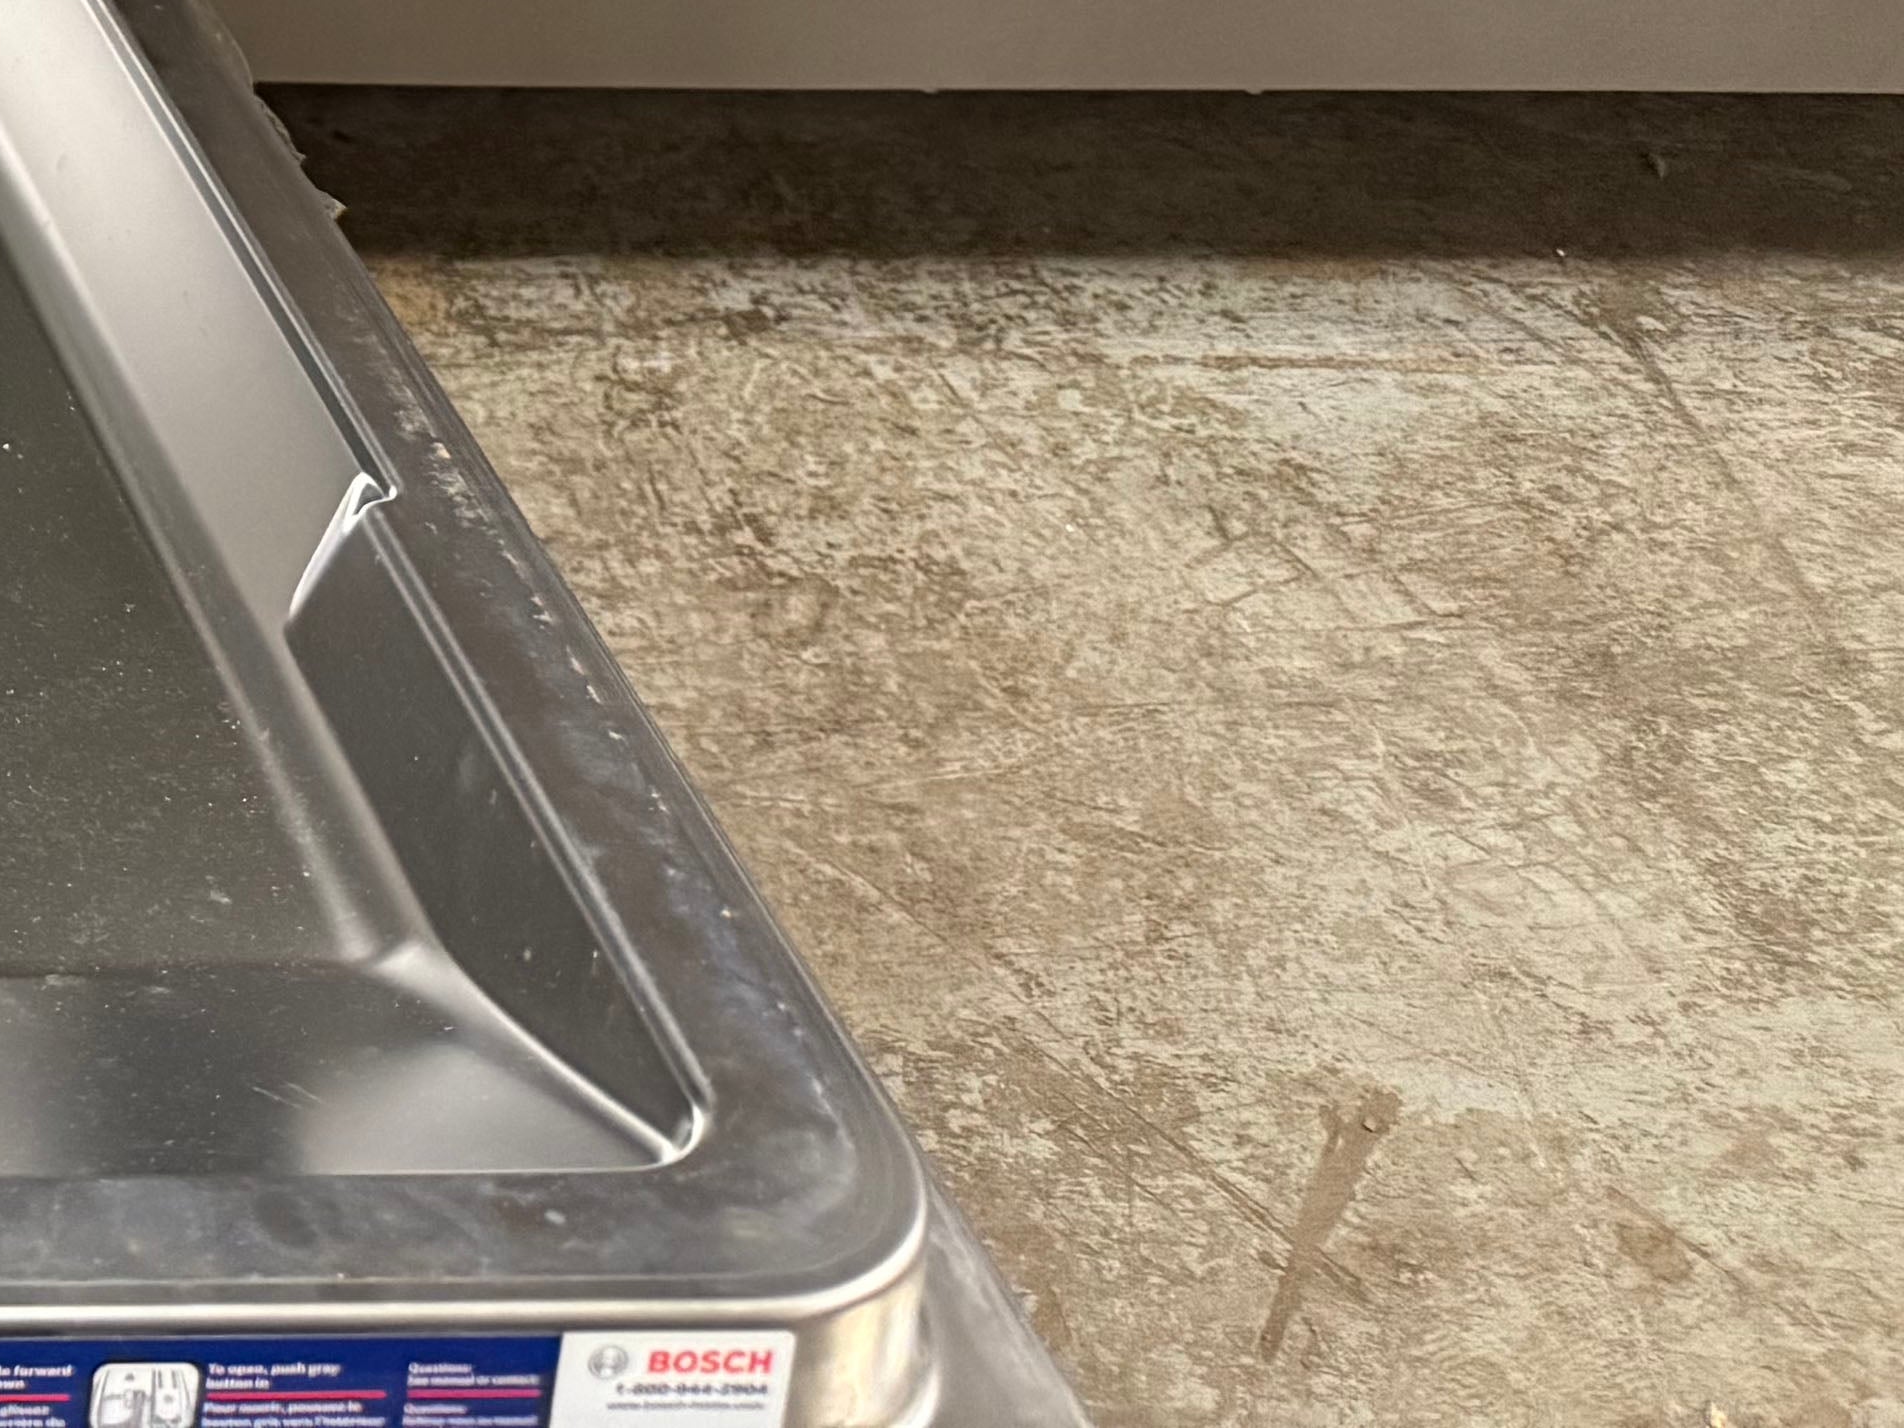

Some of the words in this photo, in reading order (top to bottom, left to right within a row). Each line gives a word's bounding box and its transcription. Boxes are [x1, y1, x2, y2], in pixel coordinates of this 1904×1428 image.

[648, 1350, 773, 1374] BOSCH
[13, 1365, 73, 1377] forward
[208, 1363, 225, 1375] To
[271, 1362, 306, 1376] push
[206, 1377, 253, 1389] button
